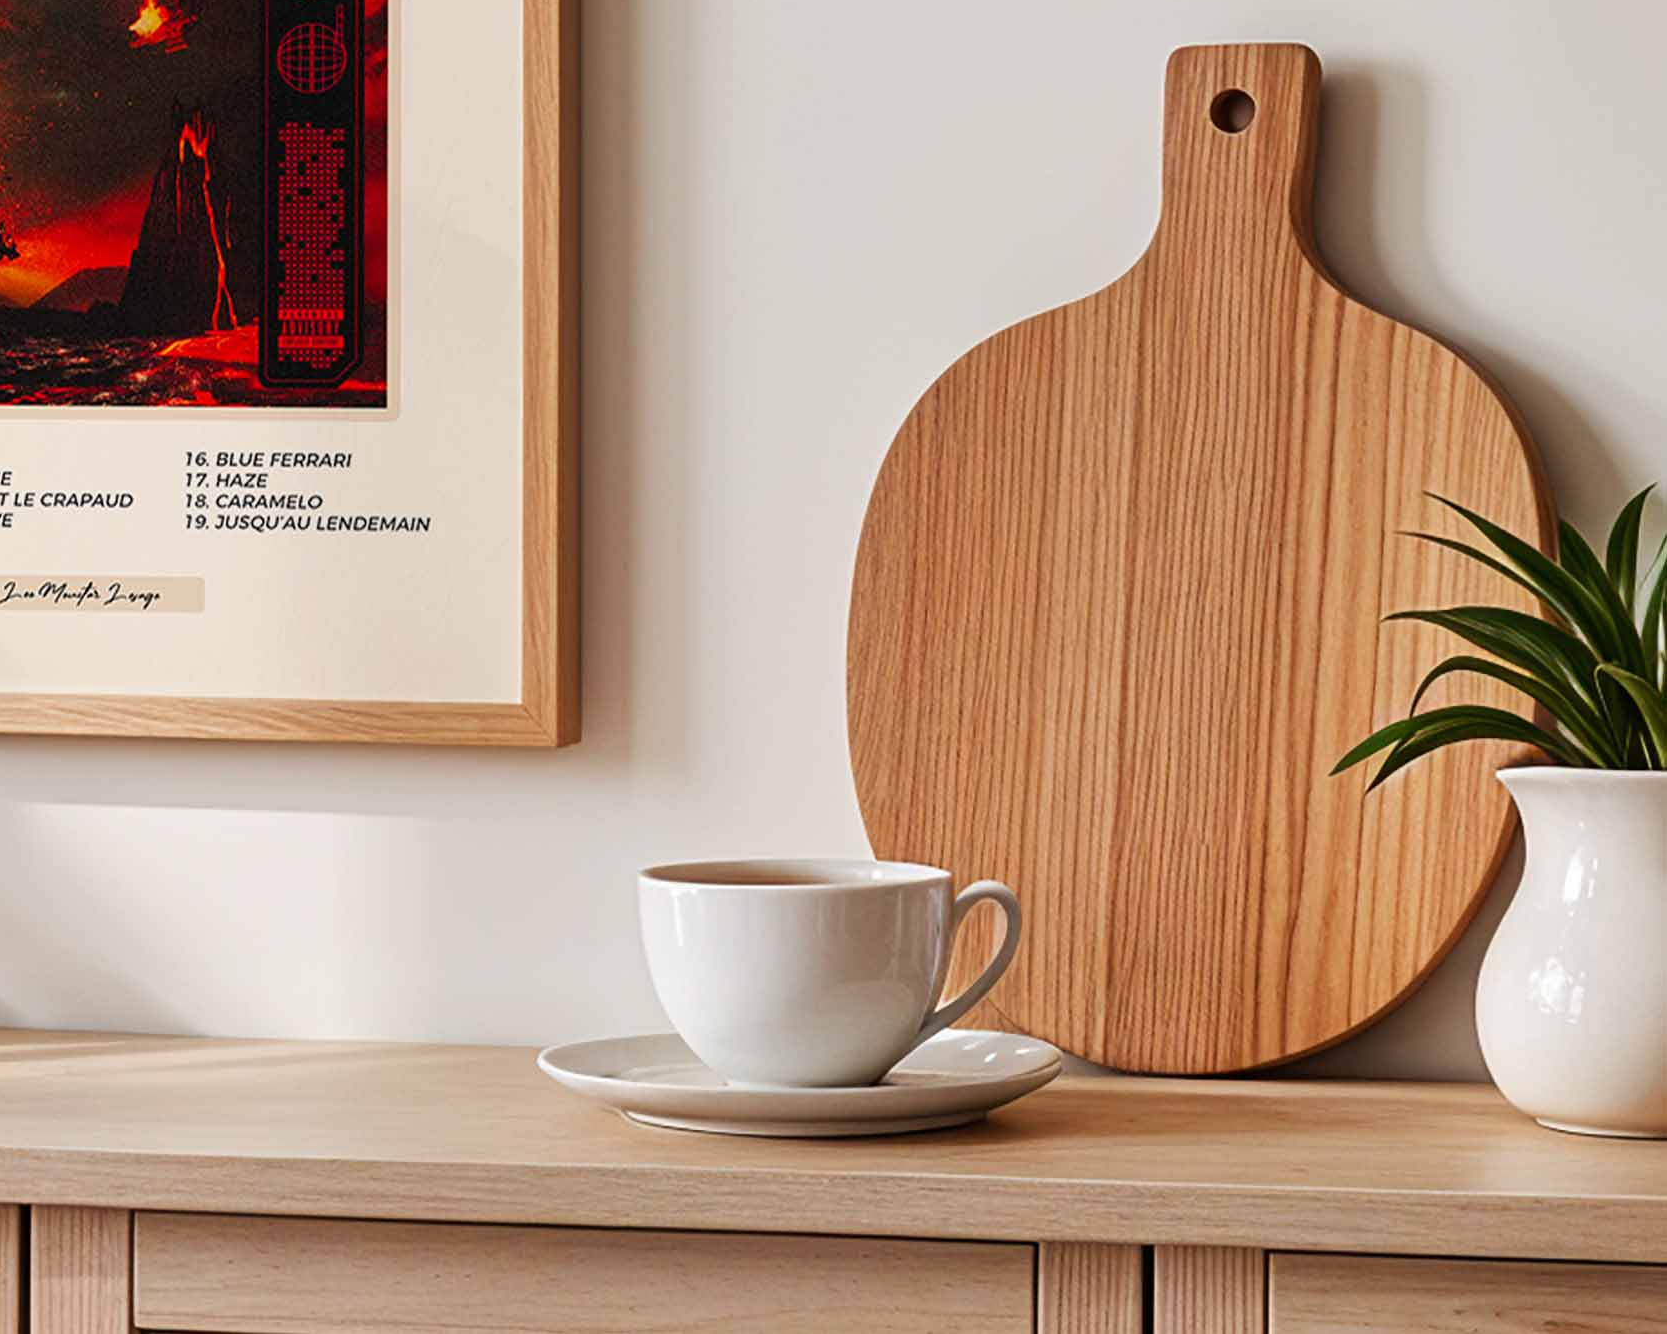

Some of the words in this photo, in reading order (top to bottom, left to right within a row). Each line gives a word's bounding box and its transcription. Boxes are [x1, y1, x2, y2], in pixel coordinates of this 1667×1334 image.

[187, 452, 209, 466] 16.
[216, 452, 264, 467] BLUE
[270, 453, 352, 468] FERRARI
[186, 472, 209, 488] 17.
[216, 473, 268, 488] HAZE
[14, 492, 35, 507] LE
[40, 493, 134, 508] CRAPAUD
[186, 493, 209, 509] 18.
[216, 494, 323, 510] CARAMELO
[186, 514, 209, 530] 19.
[215, 514, 311, 533] JUSQU'AU
[317, 516, 431, 532] LENDEMAIN
